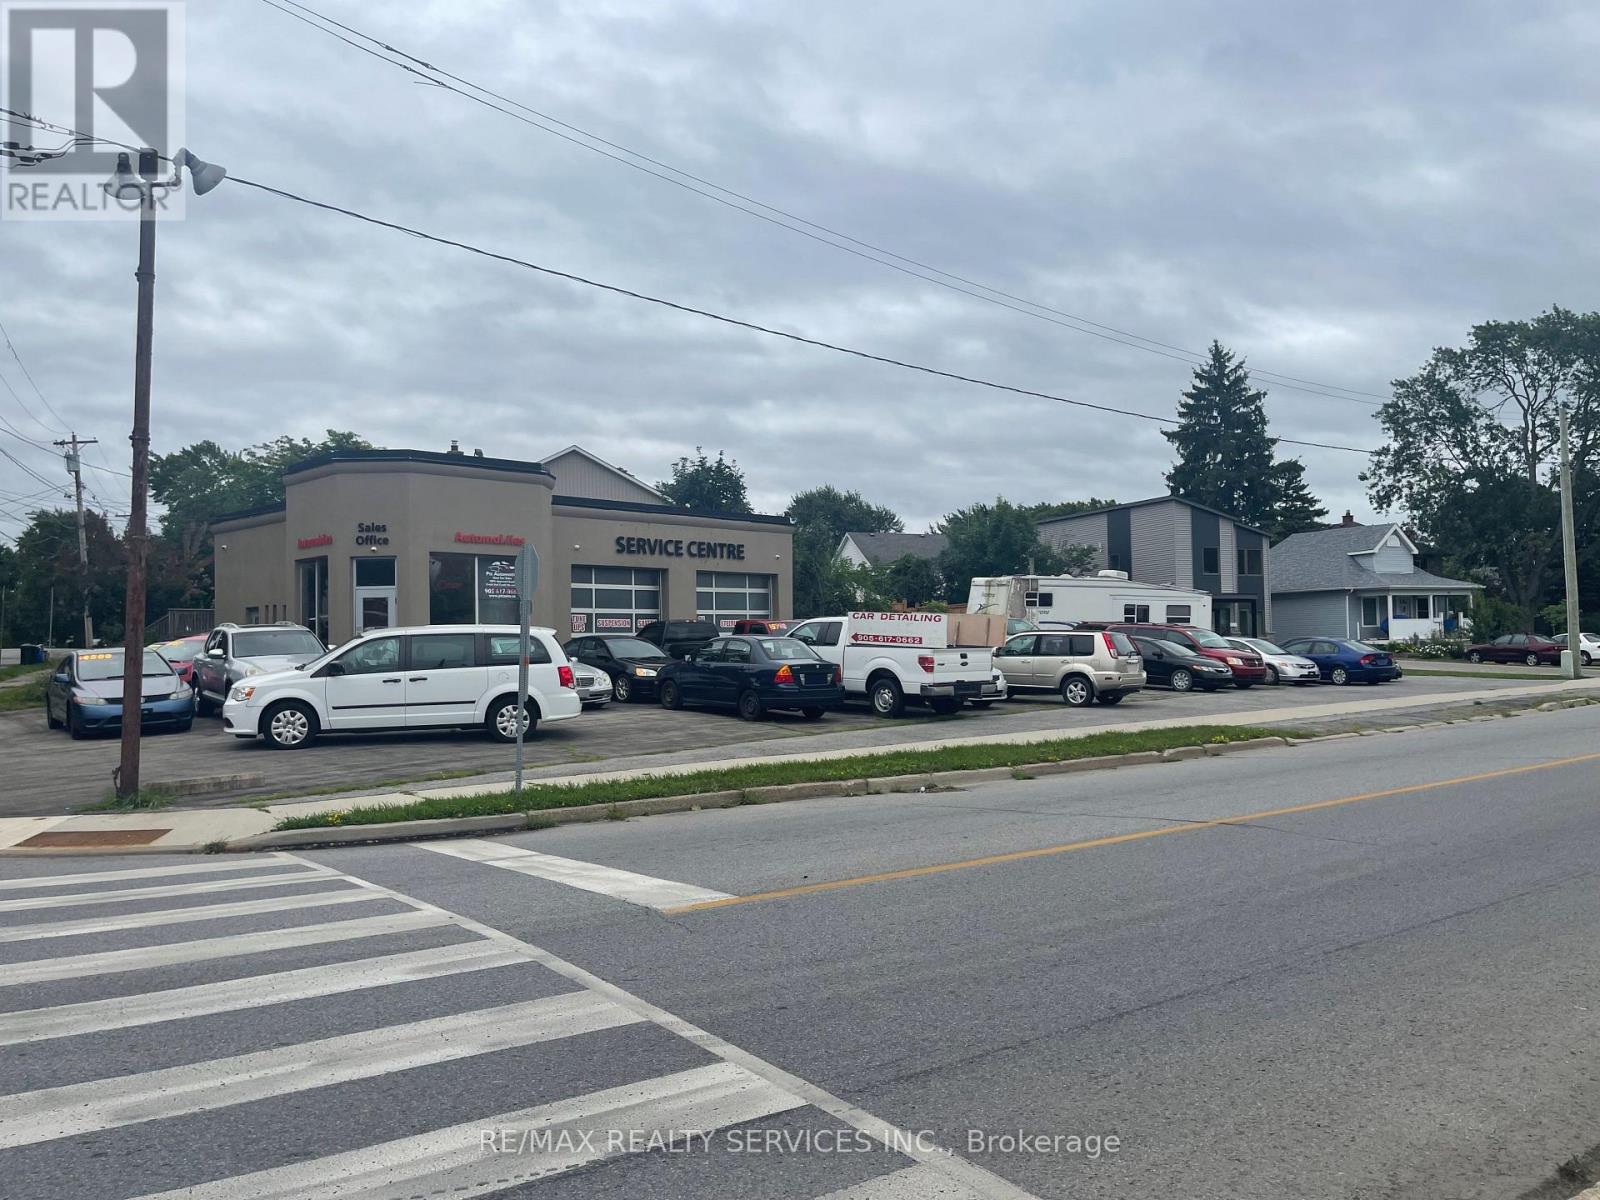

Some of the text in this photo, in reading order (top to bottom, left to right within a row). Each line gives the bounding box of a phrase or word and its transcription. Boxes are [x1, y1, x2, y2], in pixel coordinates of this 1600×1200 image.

[358, 522, 387, 533] Sales
[356, 534, 390, 546] Office
[616, 536, 746, 561] SERVICE CENTRE
[852, 612, 942, 623] CAR DETAILING
[573, 623, 585, 632] UPS
[597, 619, 631, 628] SUSPENSION
[857, 634, 921, 644] 905-617-0662
